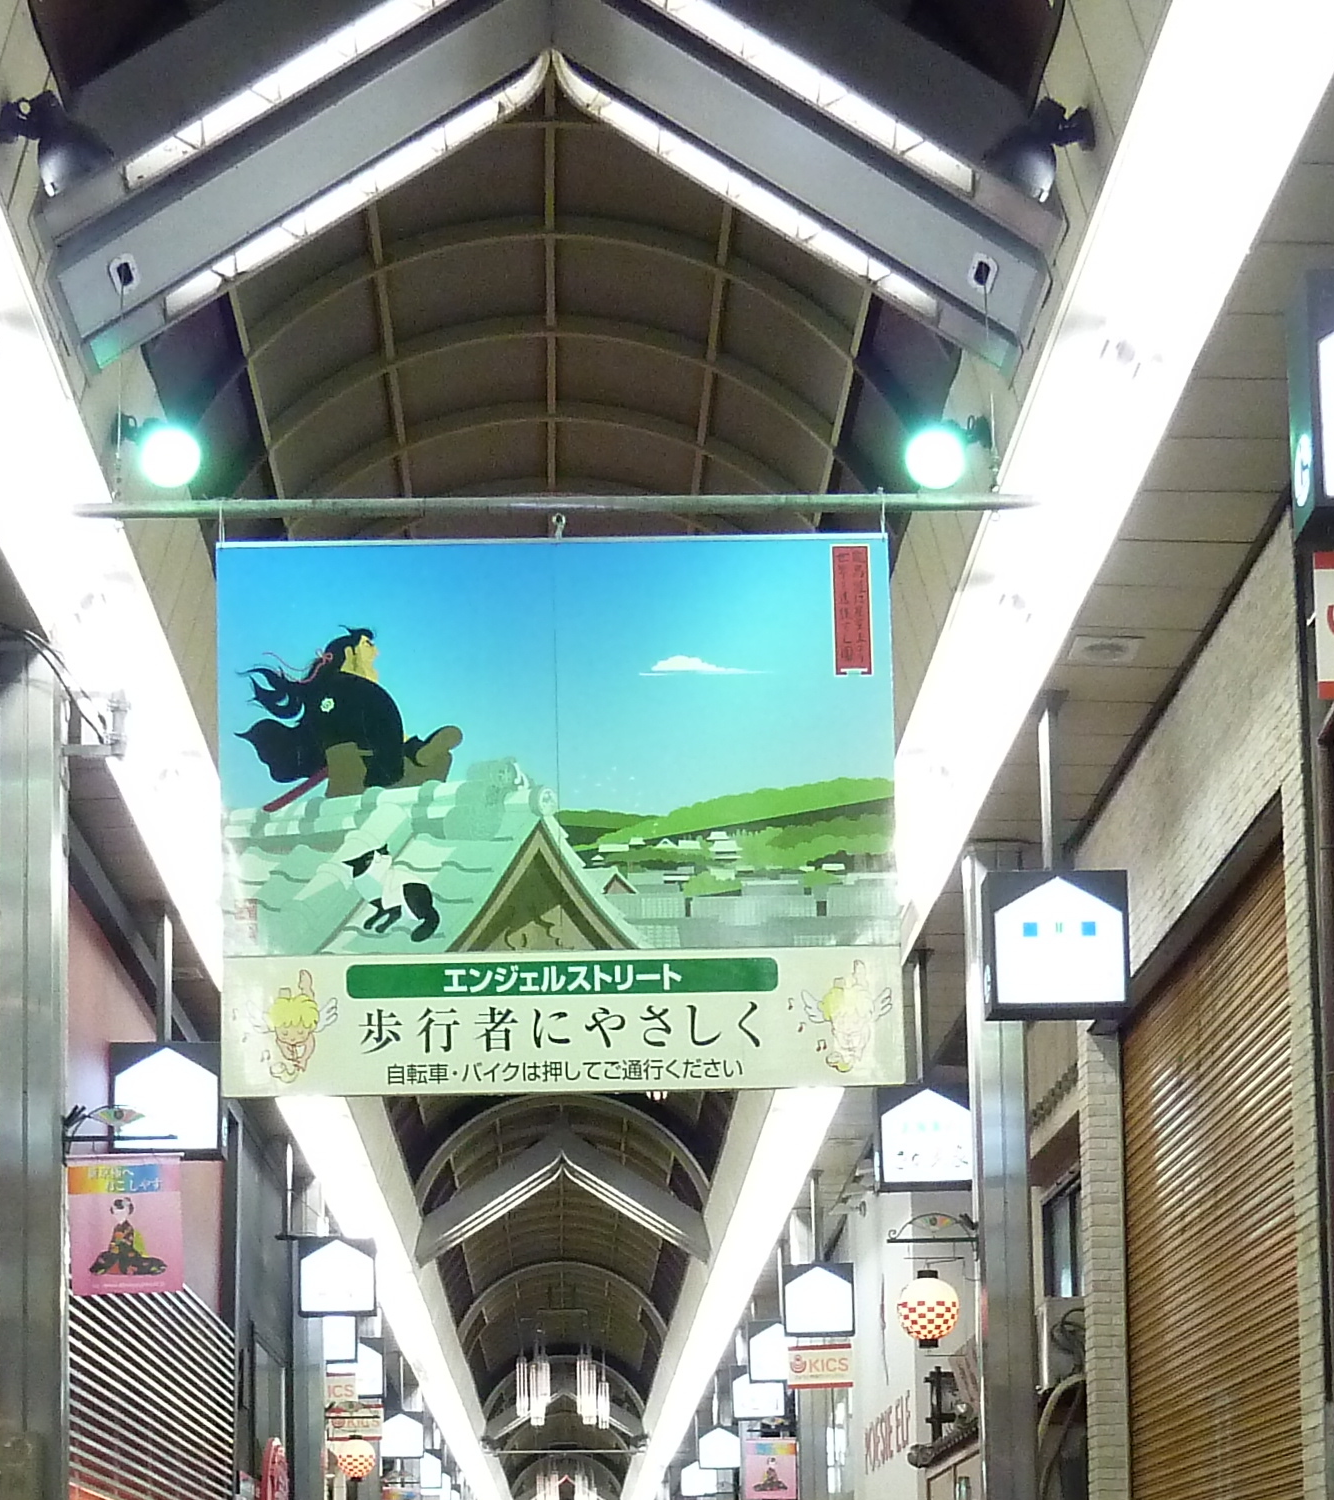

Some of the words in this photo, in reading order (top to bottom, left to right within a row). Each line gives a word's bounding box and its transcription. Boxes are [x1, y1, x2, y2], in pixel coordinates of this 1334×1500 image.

[442, 966, 683, 994] エンジェルストリート
[358, 1000, 765, 1056] 歩行者にやさしく
[385, 1056, 745, 1088] 自転車・バイクは押してご通行ください
[808, 1357, 849, 1373] KICS
[327, 1383, 354, 1399] ICS
[895, 1389, 911, 1454] ELF
